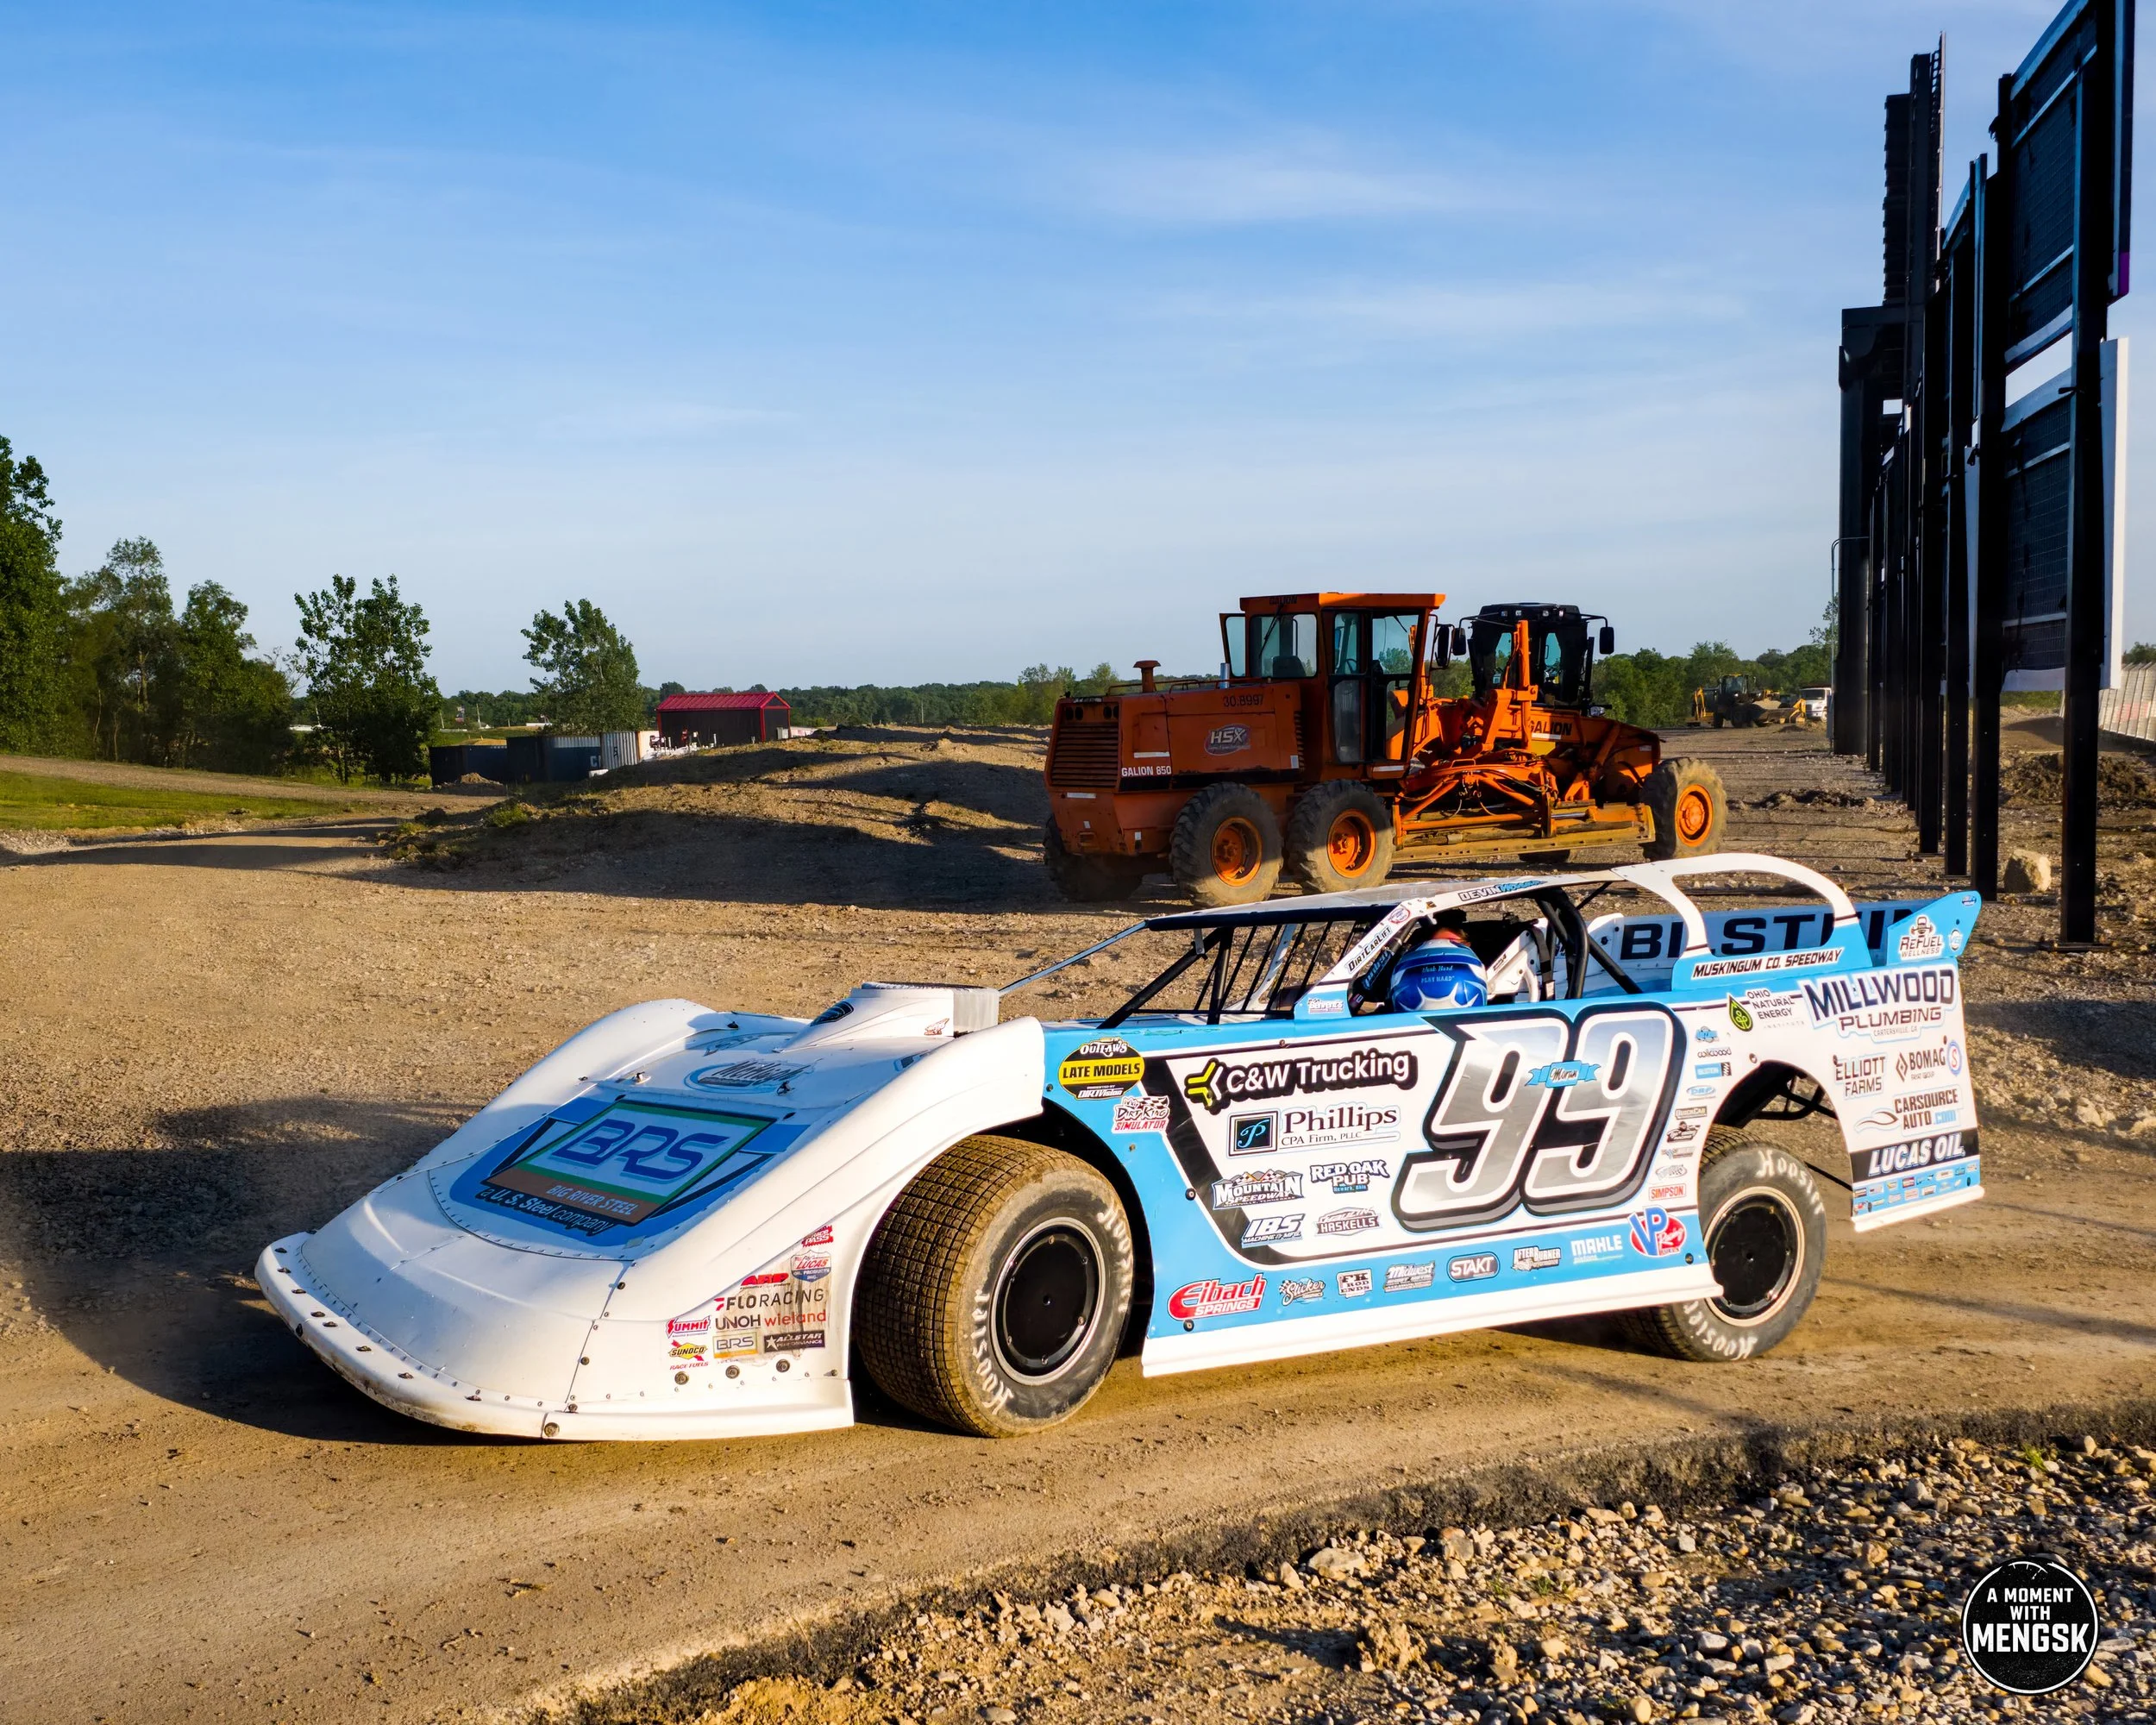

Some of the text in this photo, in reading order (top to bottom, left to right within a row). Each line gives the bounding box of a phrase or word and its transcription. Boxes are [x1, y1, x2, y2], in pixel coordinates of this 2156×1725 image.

[1210, 727, 1247, 744] HSX
[1121, 766, 1171, 776] GALION 850
[1458, 886, 1501, 901] DEVIN
[1900, 935, 1942, 950] REFUEL
[1902, 948, 1940, 958] WELLNESS
[1693, 959, 1763, 978] MUSKINGUM
[1785, 950, 1844, 968] SPEEDWAY
[1747, 989, 1771, 999] OHIO
[1804, 969, 1954, 1021] MILLWOOD
[1752, 997, 1795, 1009] NATURAL
[1758, 1008, 1793, 1019] ENERGY
[1839, 1007, 1942, 1031] PLUMBING
[1908, 1048, 1946, 1070] BOMAG
[1062, 1063, 1141, 1079] LATE MODELS
[1226, 1051, 1409, 1093] C&W Trucking
[1835, 1056, 1886, 1081] ELLIOTT
[1846, 1077, 1882, 1096] FARMS
[1895, 1089, 1959, 1113] CARSOURCE
[1283, 1106, 1398, 1134] Phillips
[1394, 1007, 1680, 1223] 99
[1115, 1120, 1165, 1131] SIMULATOR
[1282, 1131, 1363, 1145] CPA Firm, PLLC
[549, 1119, 730, 1181] BRS
[1868, 1132, 1965, 1176] LUCAS OIL
[1311, 1160, 1389, 1182] RED OAK
[1332, 1174, 1369, 1187] PUB
[1214, 1175, 1303, 1206] MOUNTAIN
[1225, 1191, 1291, 1205] SPEEDWAY
[1651, 1185, 1683, 1199] SIMPSON
[546, 1185, 639, 1217] BIG RIVER STEEL
[480, 1188, 492, 1197] a
[520, 1197, 557, 1216] Steel
[554, 1208, 614, 1236] company
[1245, 1214, 1306, 1238] IBS
[1319, 1217, 1376, 1233] HASKELLS
[1628, 1207, 1669, 1257] VP
[805, 1235, 830, 1245] PASS
[1570, 1235, 1622, 1256] MAHLE
[796, 1259, 829, 1270] LUCAS
[1451, 1256, 1495, 1276] STAKT
[1342, 1271, 1369, 1283] FK
[1169, 1273, 1267, 1320] Eibach
[1194, 1299, 1256, 1317] SPRINGS
[667, 1318, 710, 1335] SUMMIT
[716, 1314, 761, 1330] UNOH
[764, 1311, 826, 1327] wieland
[717, 1337, 754, 1350] BRS
[776, 1333, 822, 1342] ALLSTAR
[672, 1347, 705, 1357] SUNOCO
